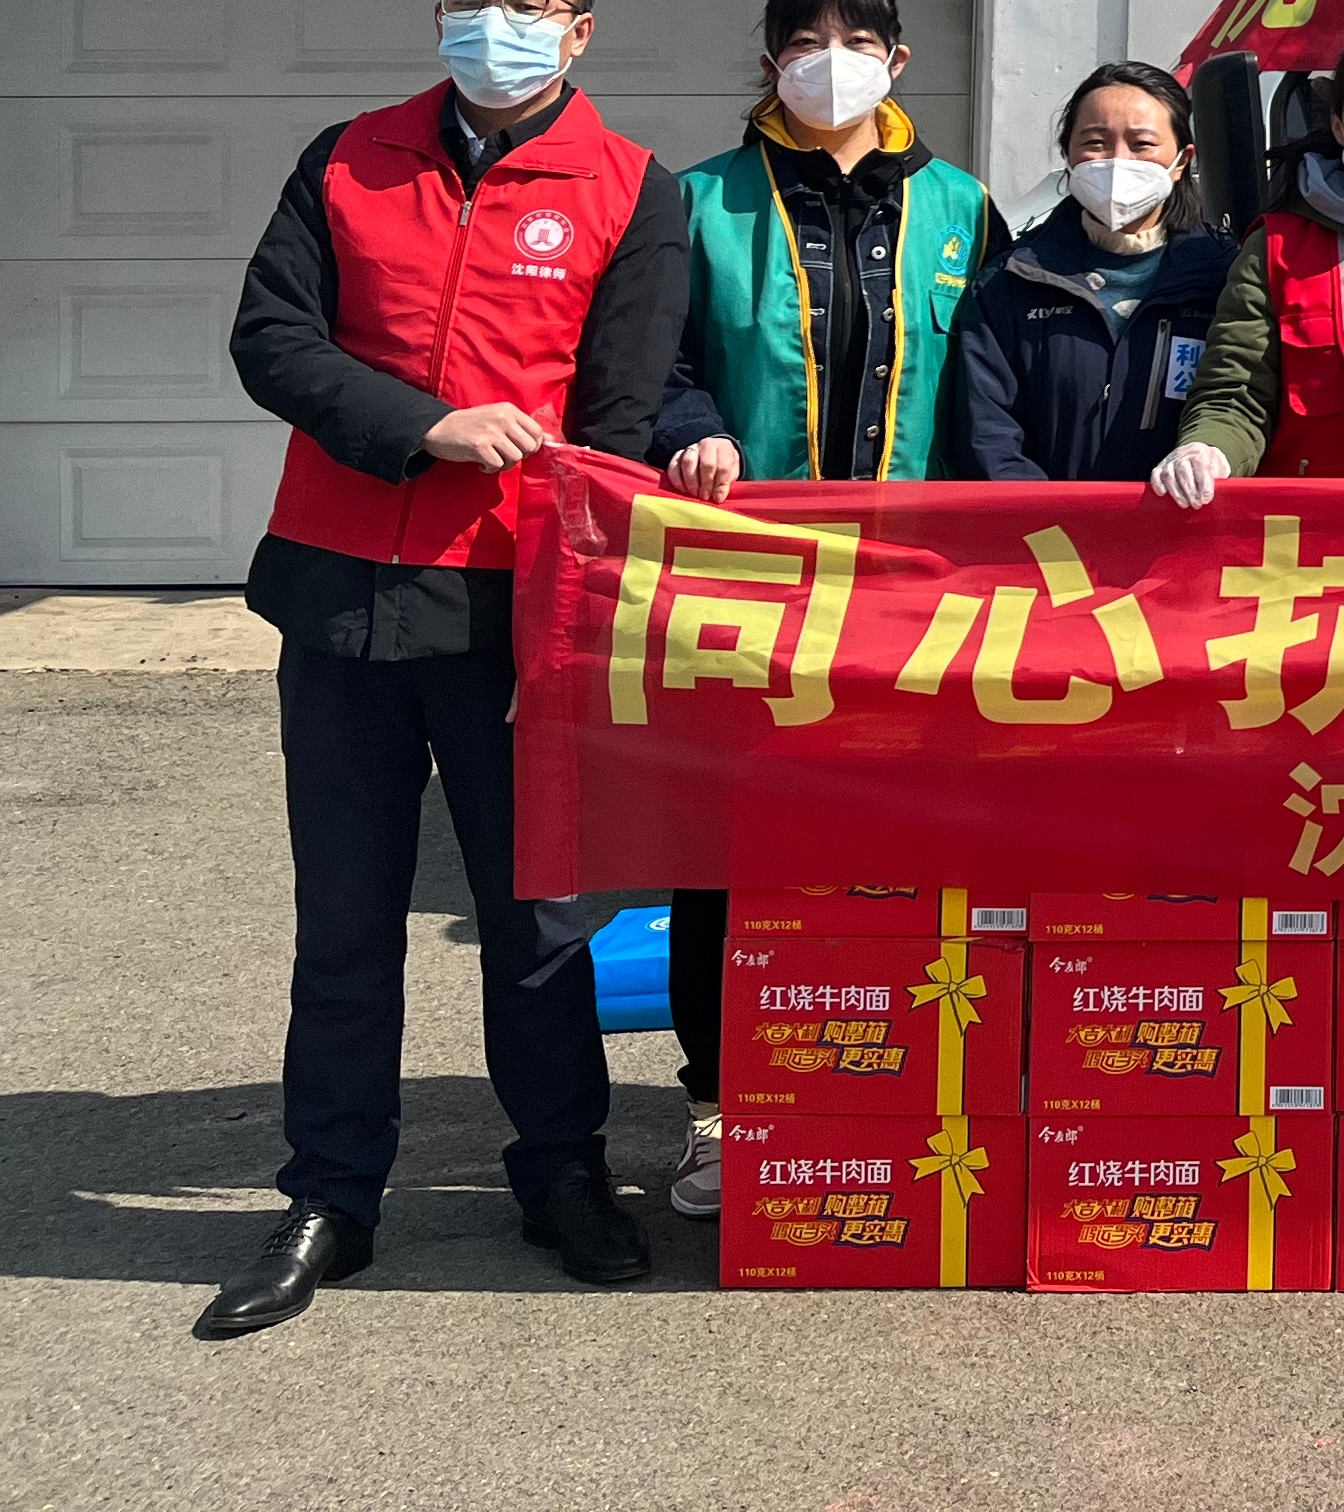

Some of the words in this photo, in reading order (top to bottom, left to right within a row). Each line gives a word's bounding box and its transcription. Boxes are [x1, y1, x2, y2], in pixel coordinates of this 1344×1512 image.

[511, 263, 567, 281] 沈阳律师
[759, 984, 891, 1011] 红烧牛肉面
[1073, 985, 1204, 1013] 红烧牛肉面
[759, 1158, 893, 1185] 红烧牛肉面
[1068, 1159, 1201, 1187] 红烧牛肉面
